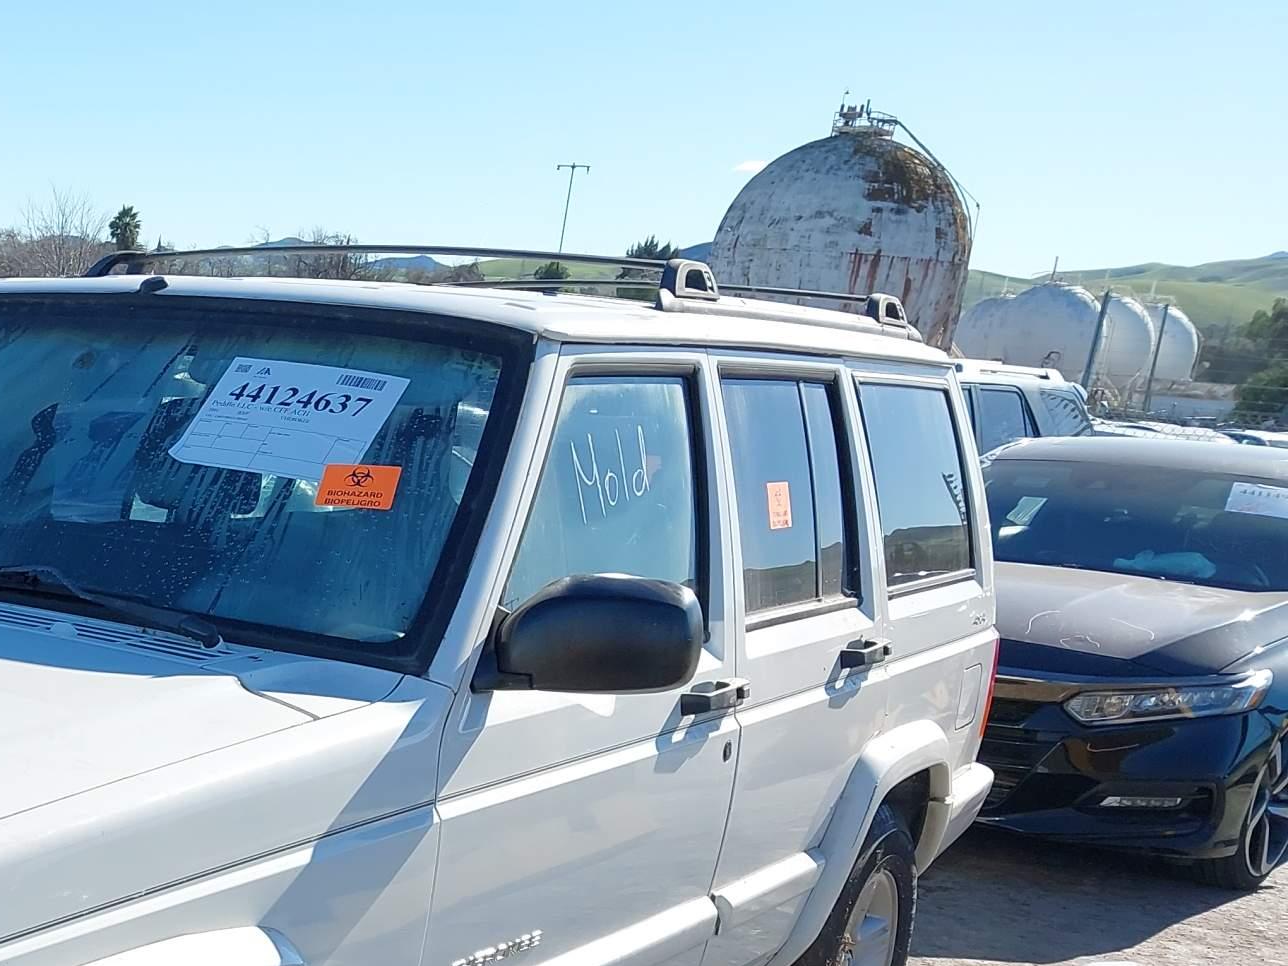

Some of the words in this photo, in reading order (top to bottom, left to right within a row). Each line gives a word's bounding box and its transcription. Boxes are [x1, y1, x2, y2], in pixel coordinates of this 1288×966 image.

[229, 381, 374, 418] 44124637
[571, 424, 650, 525] Mold
[324, 498, 381, 507] BIOPELIGRO
[327, 489, 383, 499] BIOHAZARD
